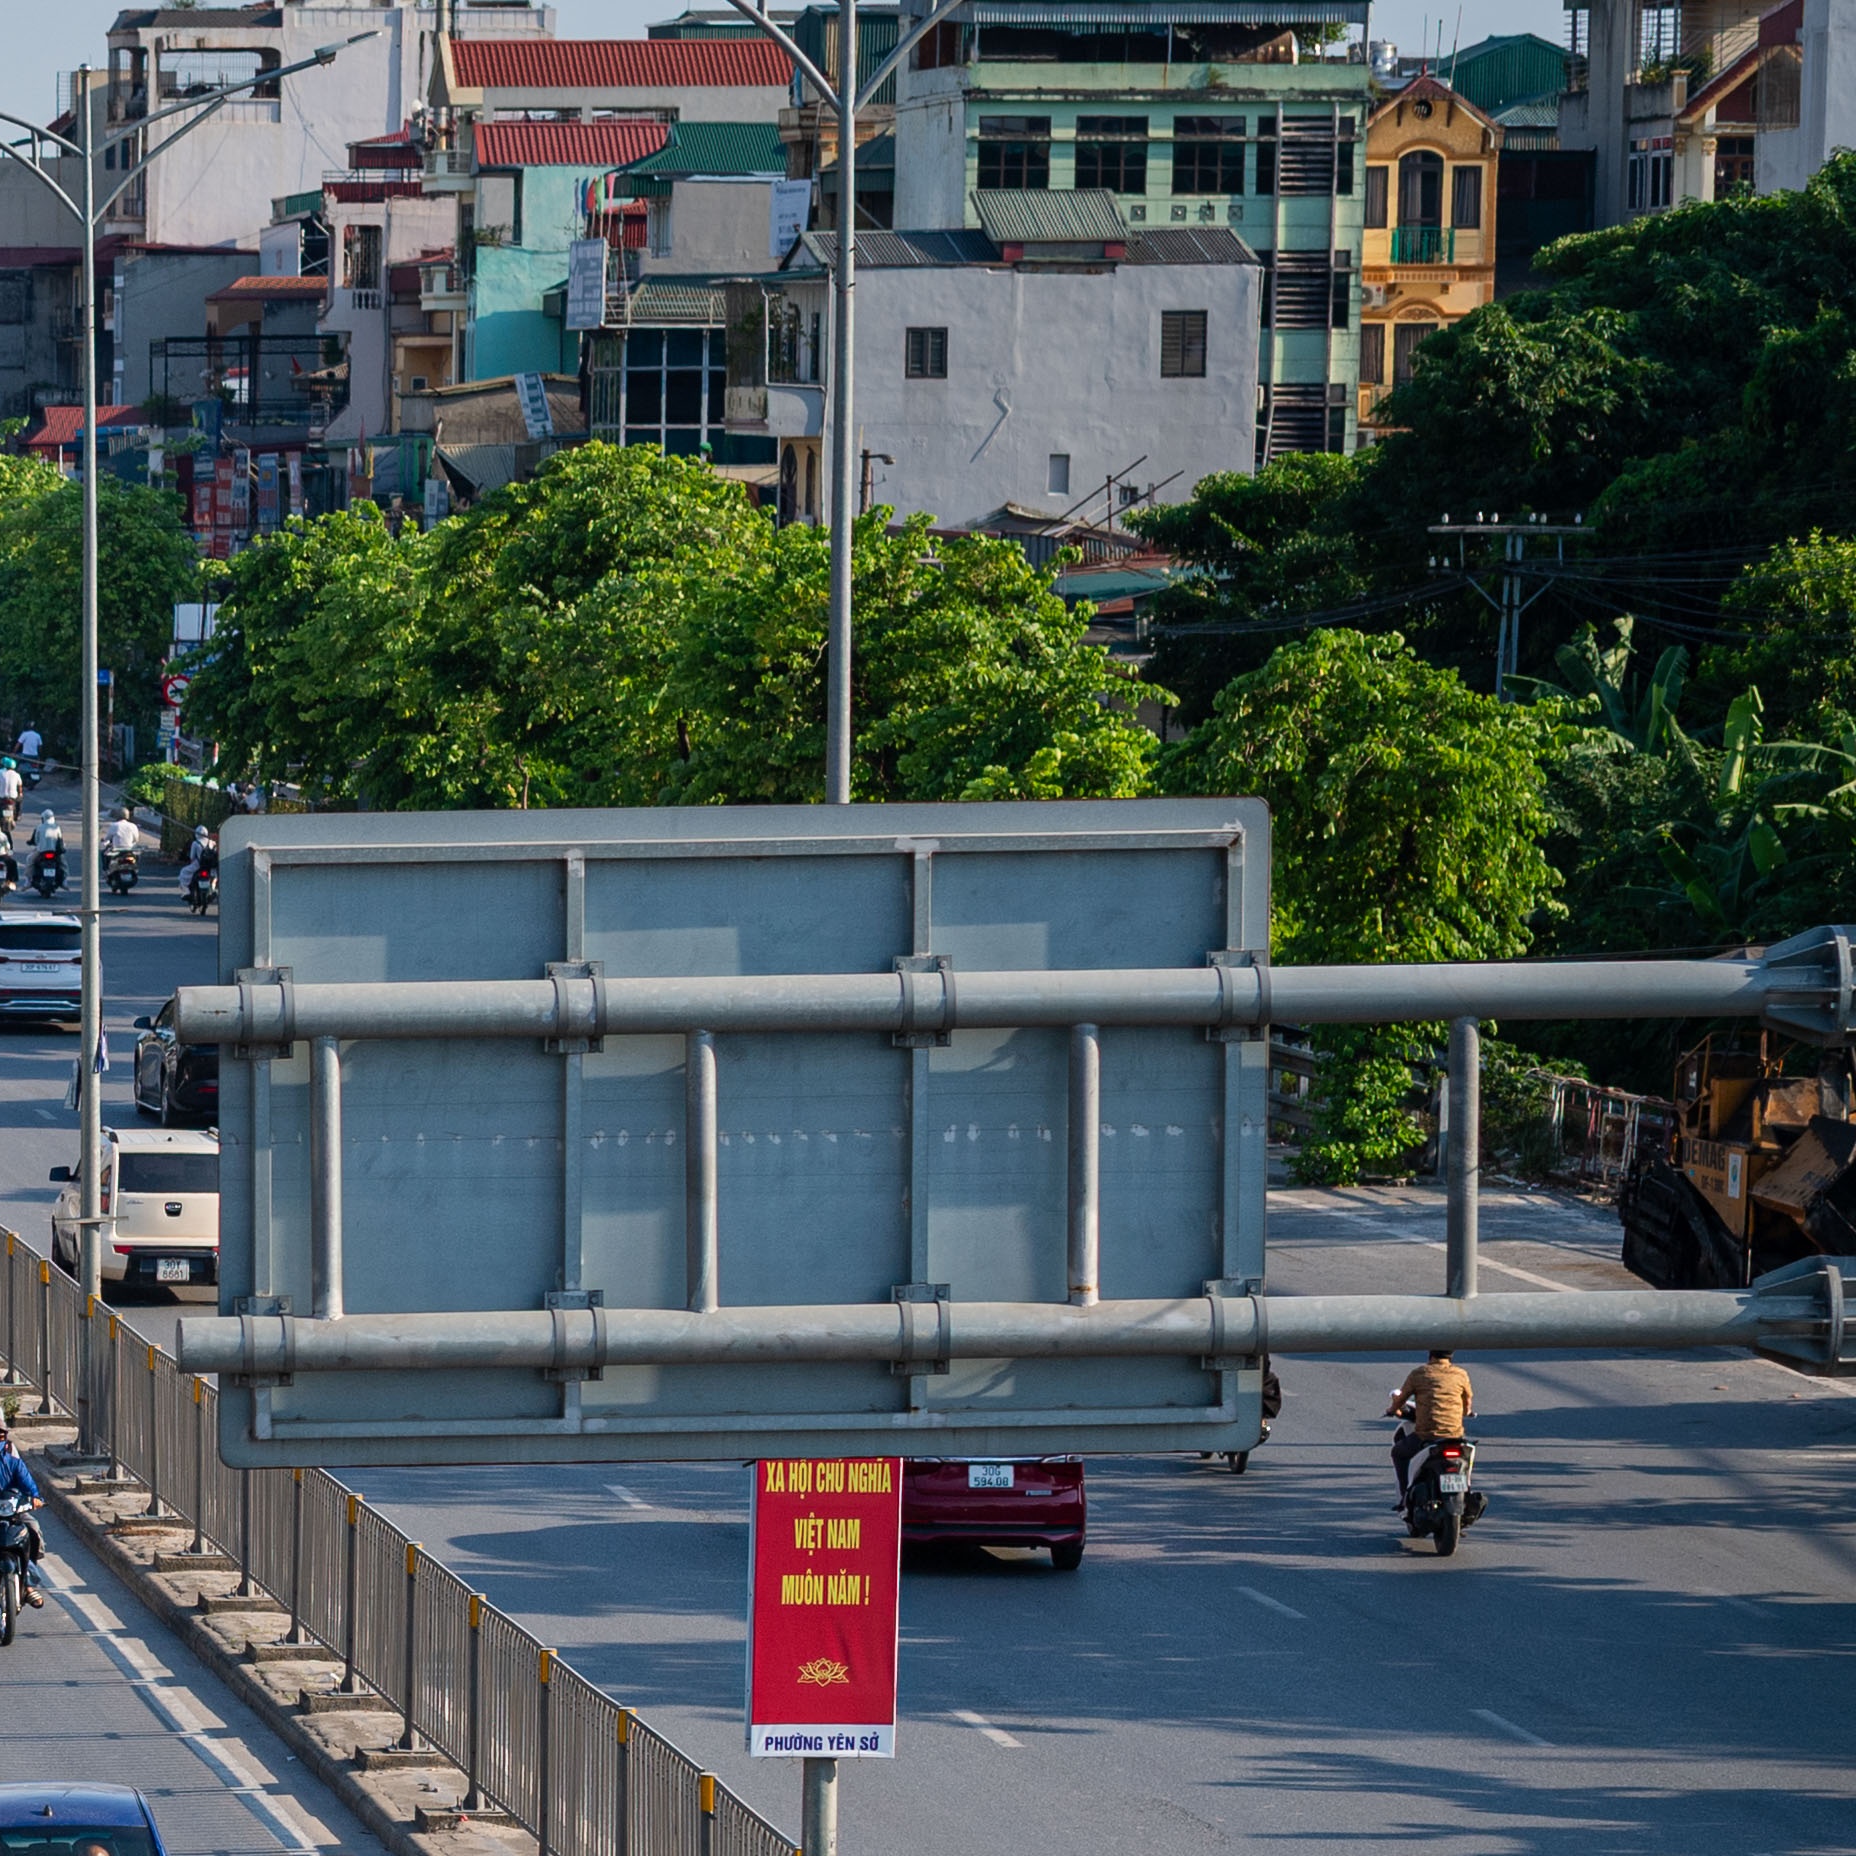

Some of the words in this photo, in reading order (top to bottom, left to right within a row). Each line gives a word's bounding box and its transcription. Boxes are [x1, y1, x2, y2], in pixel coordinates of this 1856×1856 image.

[848, 1458, 892, 1493] NGHĨA
[794, 1512, 824, 1556] VIỆT
[827, 1518, 861, 1549] NAM
[781, 1568, 824, 1605] MUÔN
[827, 1569, 861, 1605] NĂM
[764, 1732, 823, 1751] PHƯỜNG
[827, 1733, 856, 1751] YÊN
[860, 1731, 880, 1751] SỞ
